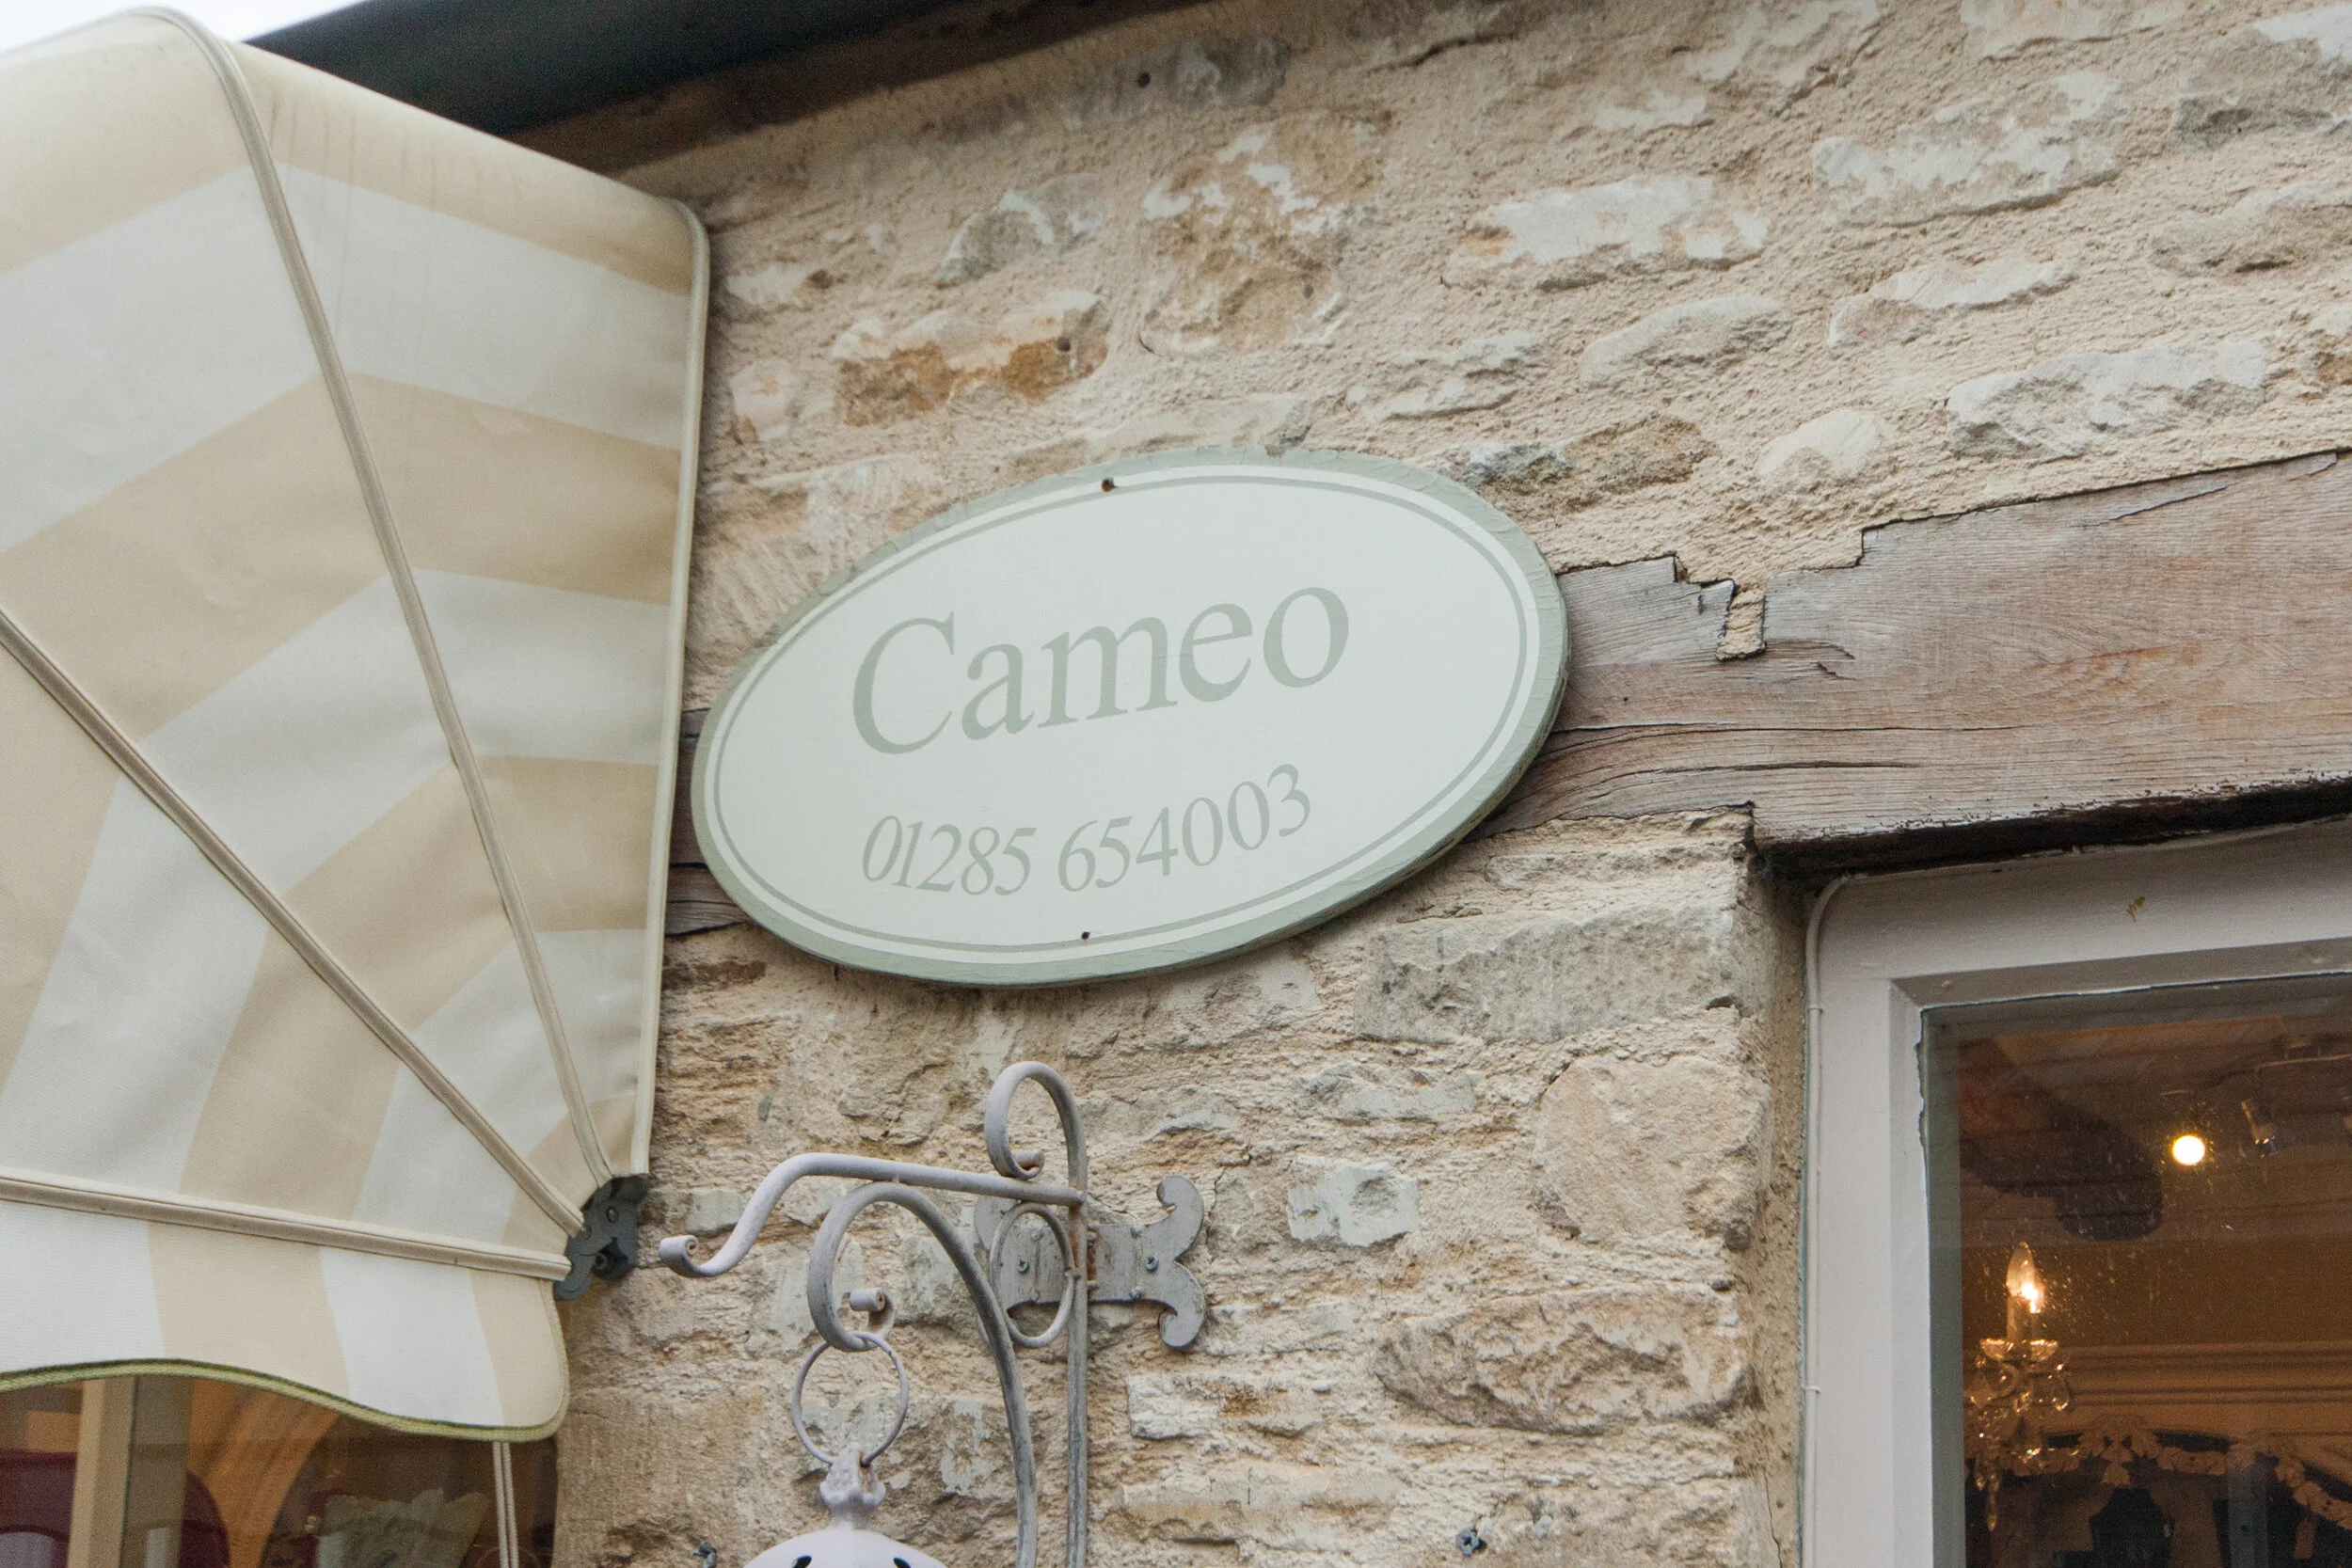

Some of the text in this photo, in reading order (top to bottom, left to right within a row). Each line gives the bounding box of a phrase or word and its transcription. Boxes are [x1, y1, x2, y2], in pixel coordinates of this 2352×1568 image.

[852, 586, 1350, 755] Cameo
[862, 763, 1311, 896] 01285 654003
